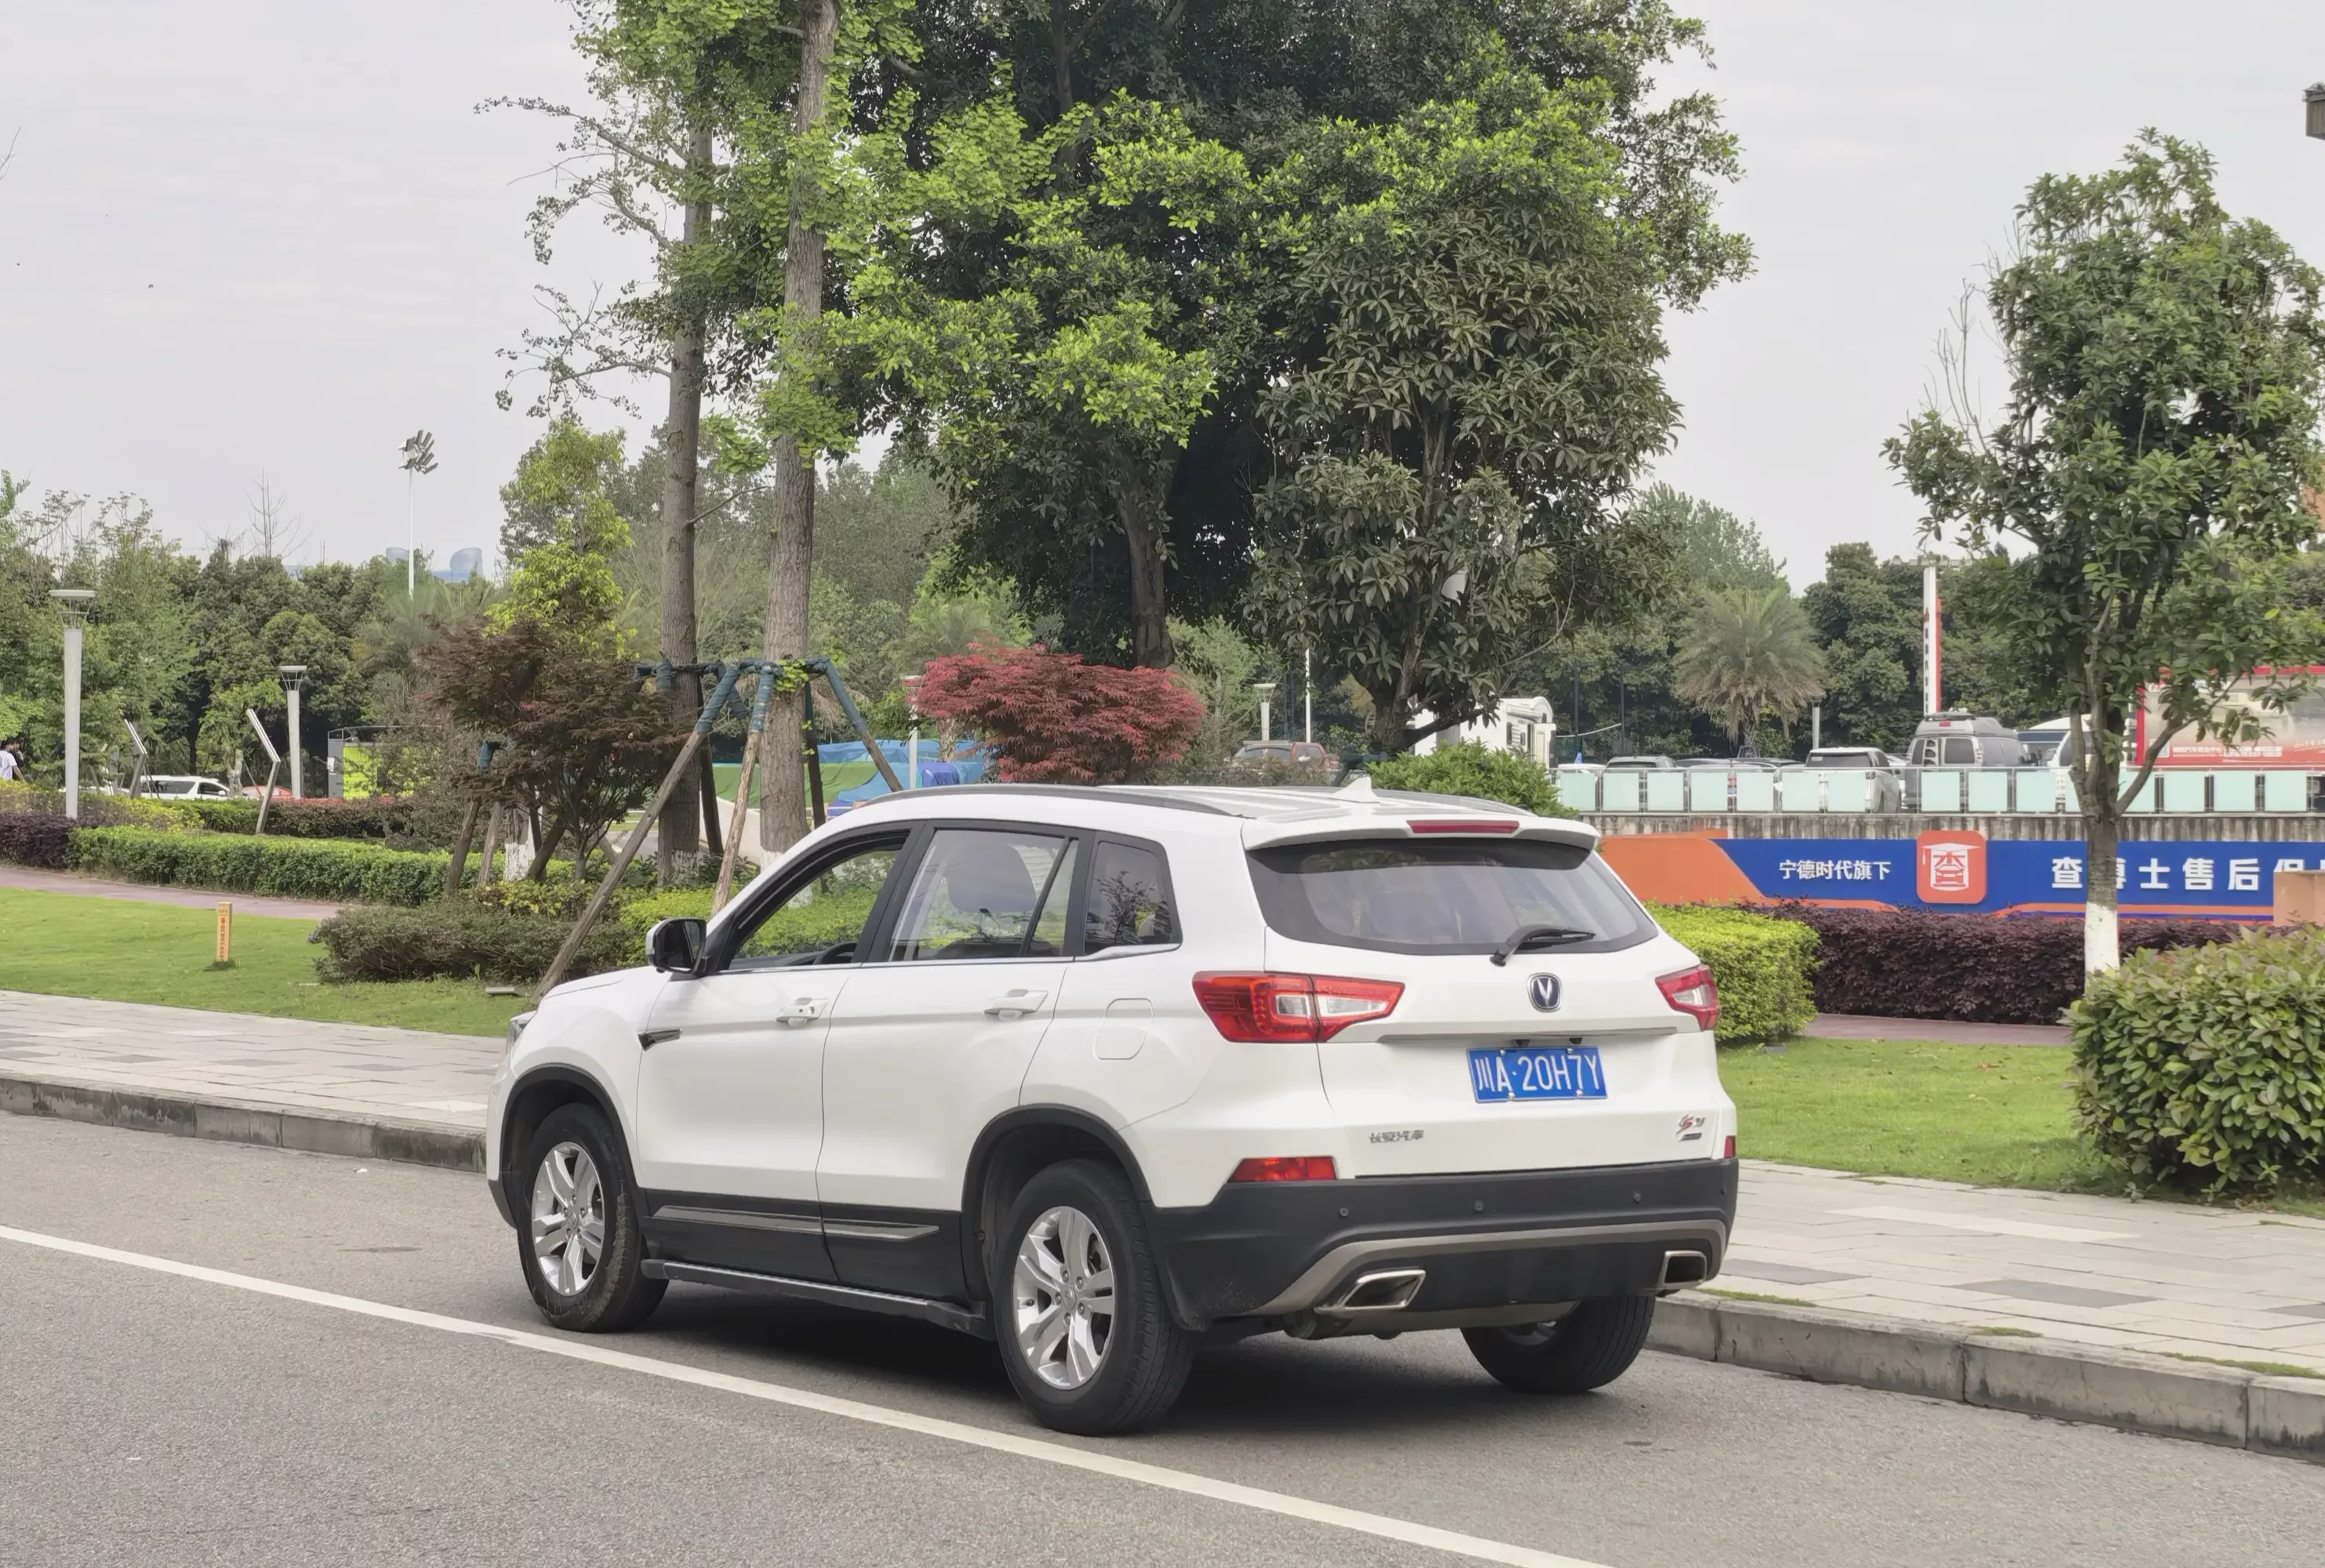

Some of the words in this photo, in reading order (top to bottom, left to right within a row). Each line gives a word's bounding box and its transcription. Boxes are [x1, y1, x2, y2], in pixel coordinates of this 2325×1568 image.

[1778, 859, 1891, 880] 宁德时代旗下
[2051, 857, 2325, 891] 查士售后
